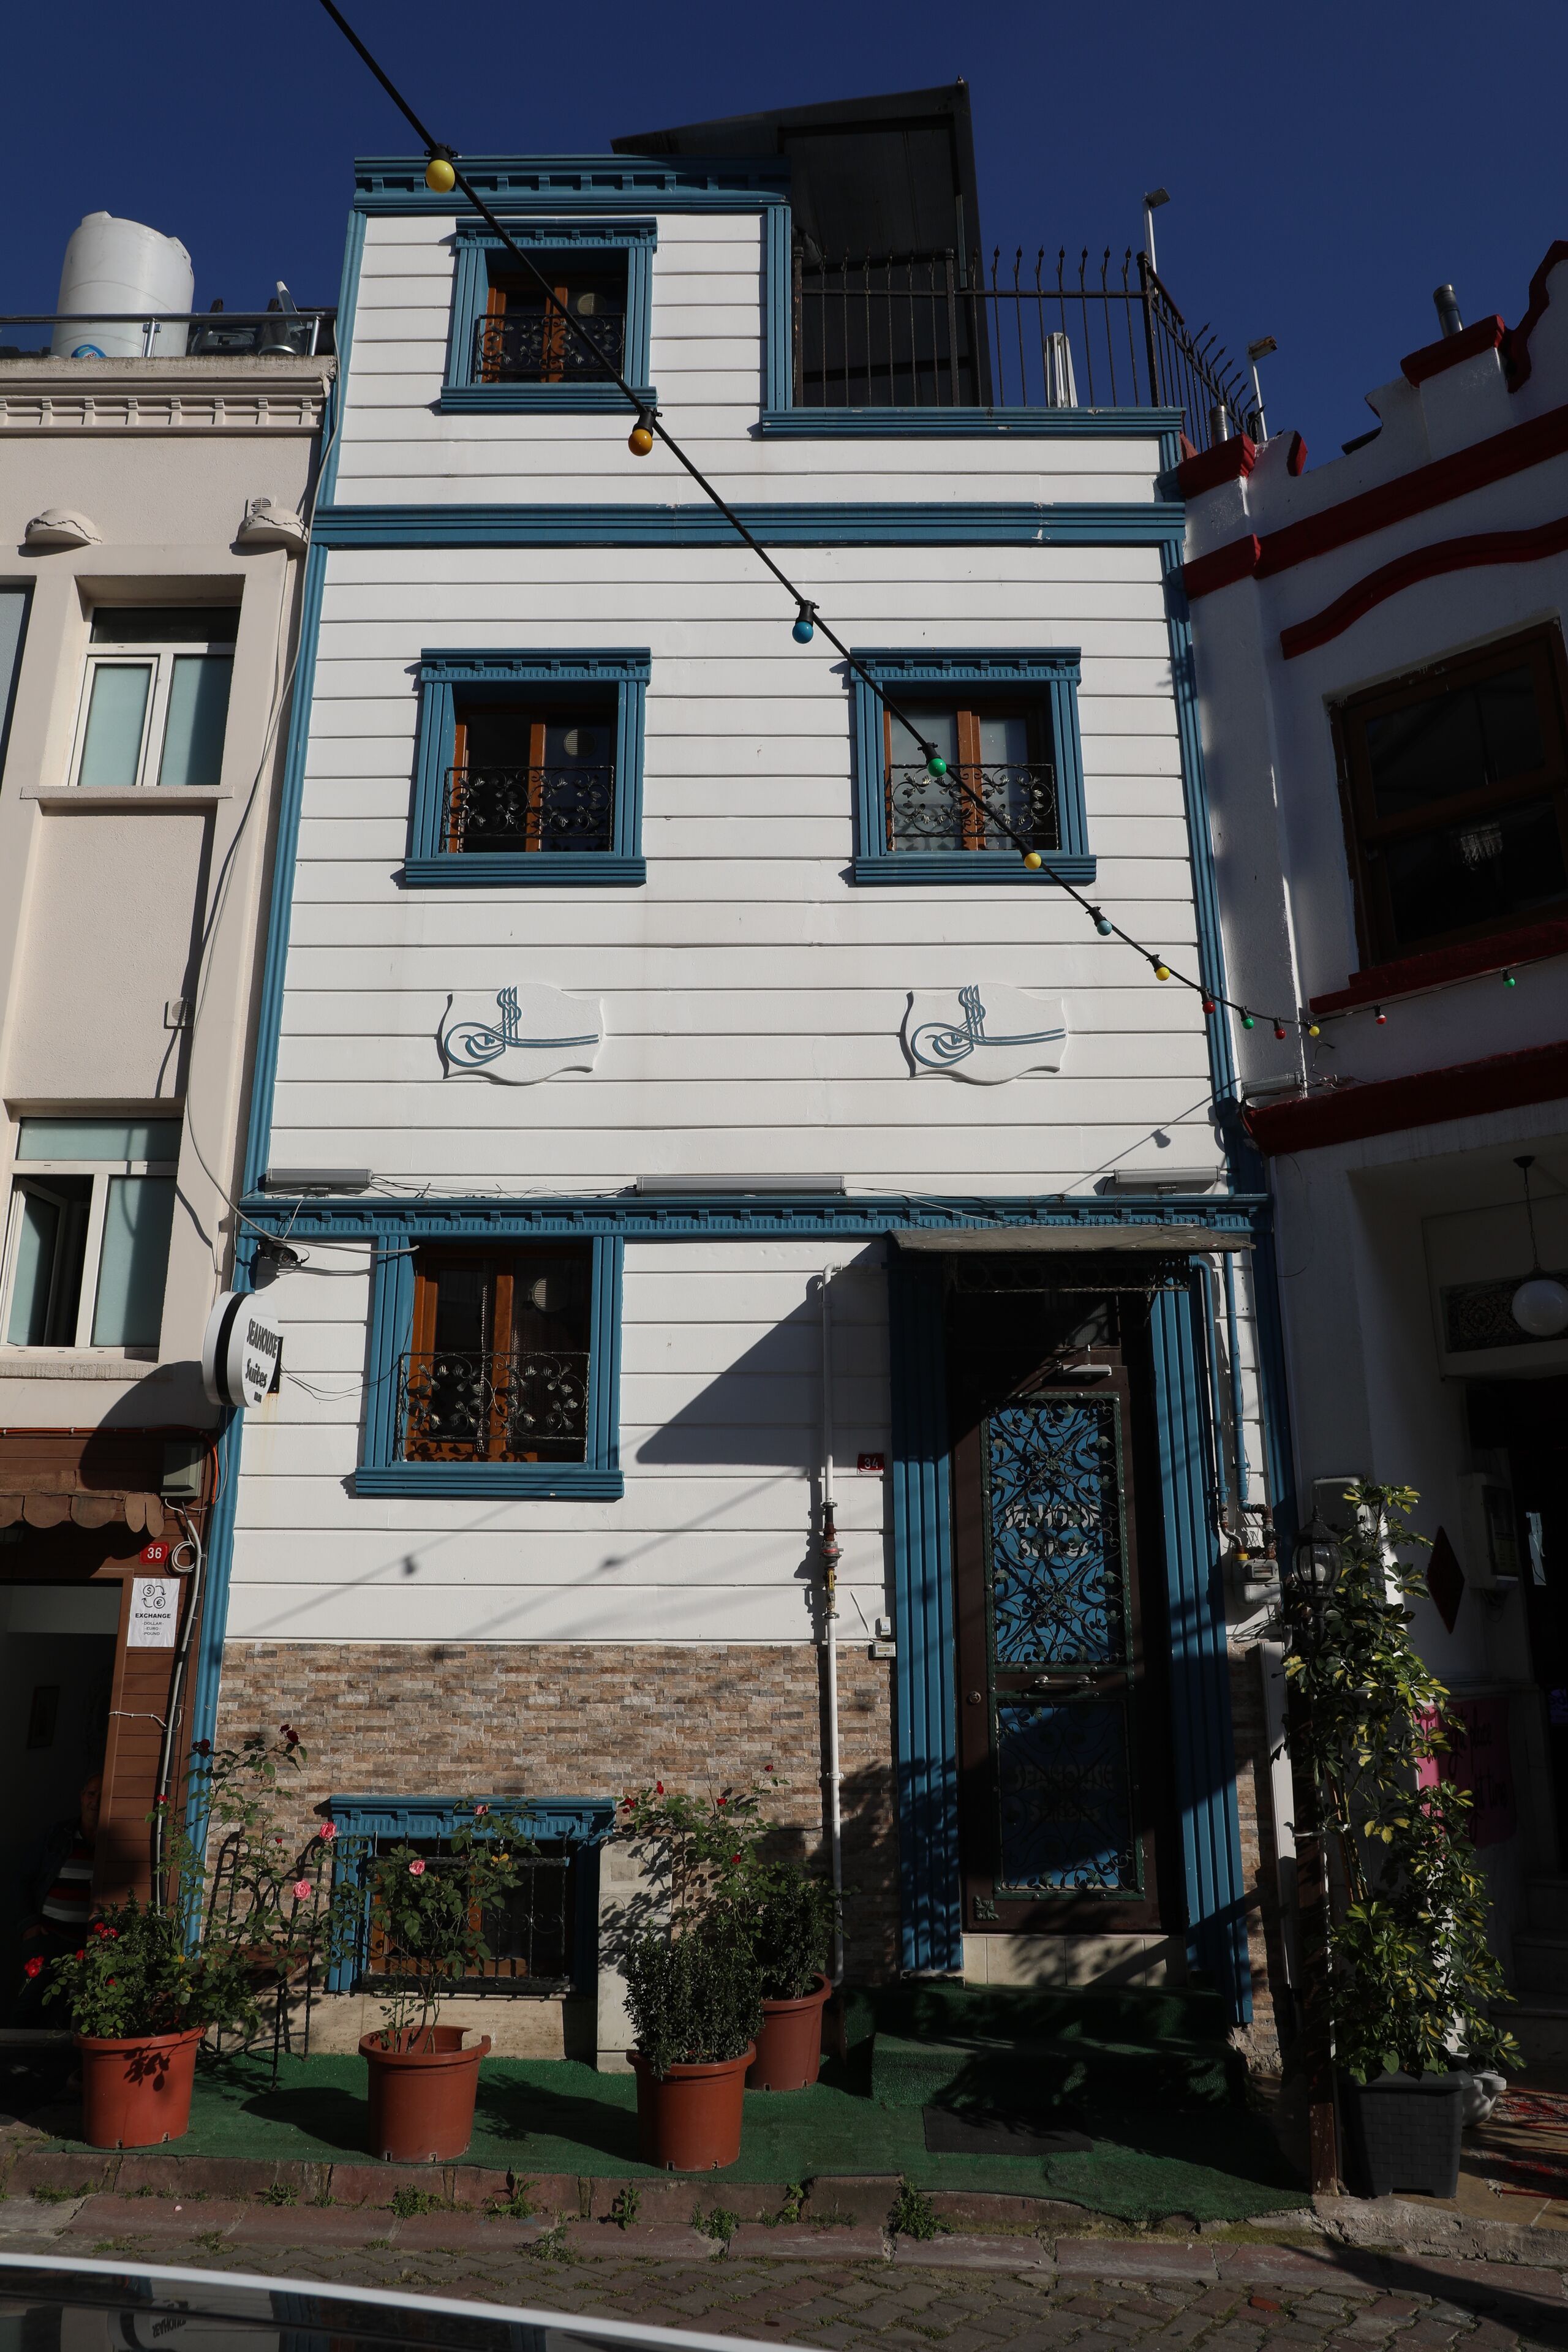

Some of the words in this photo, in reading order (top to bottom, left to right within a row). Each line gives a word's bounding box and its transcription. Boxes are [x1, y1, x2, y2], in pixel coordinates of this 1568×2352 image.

[247, 1318, 279, 1359] SEAHOUSE
[246, 1358, 268, 1389] Suites
[864, 1458, 878, 1469] 34
[147, 1547, 162, 1559] 36
